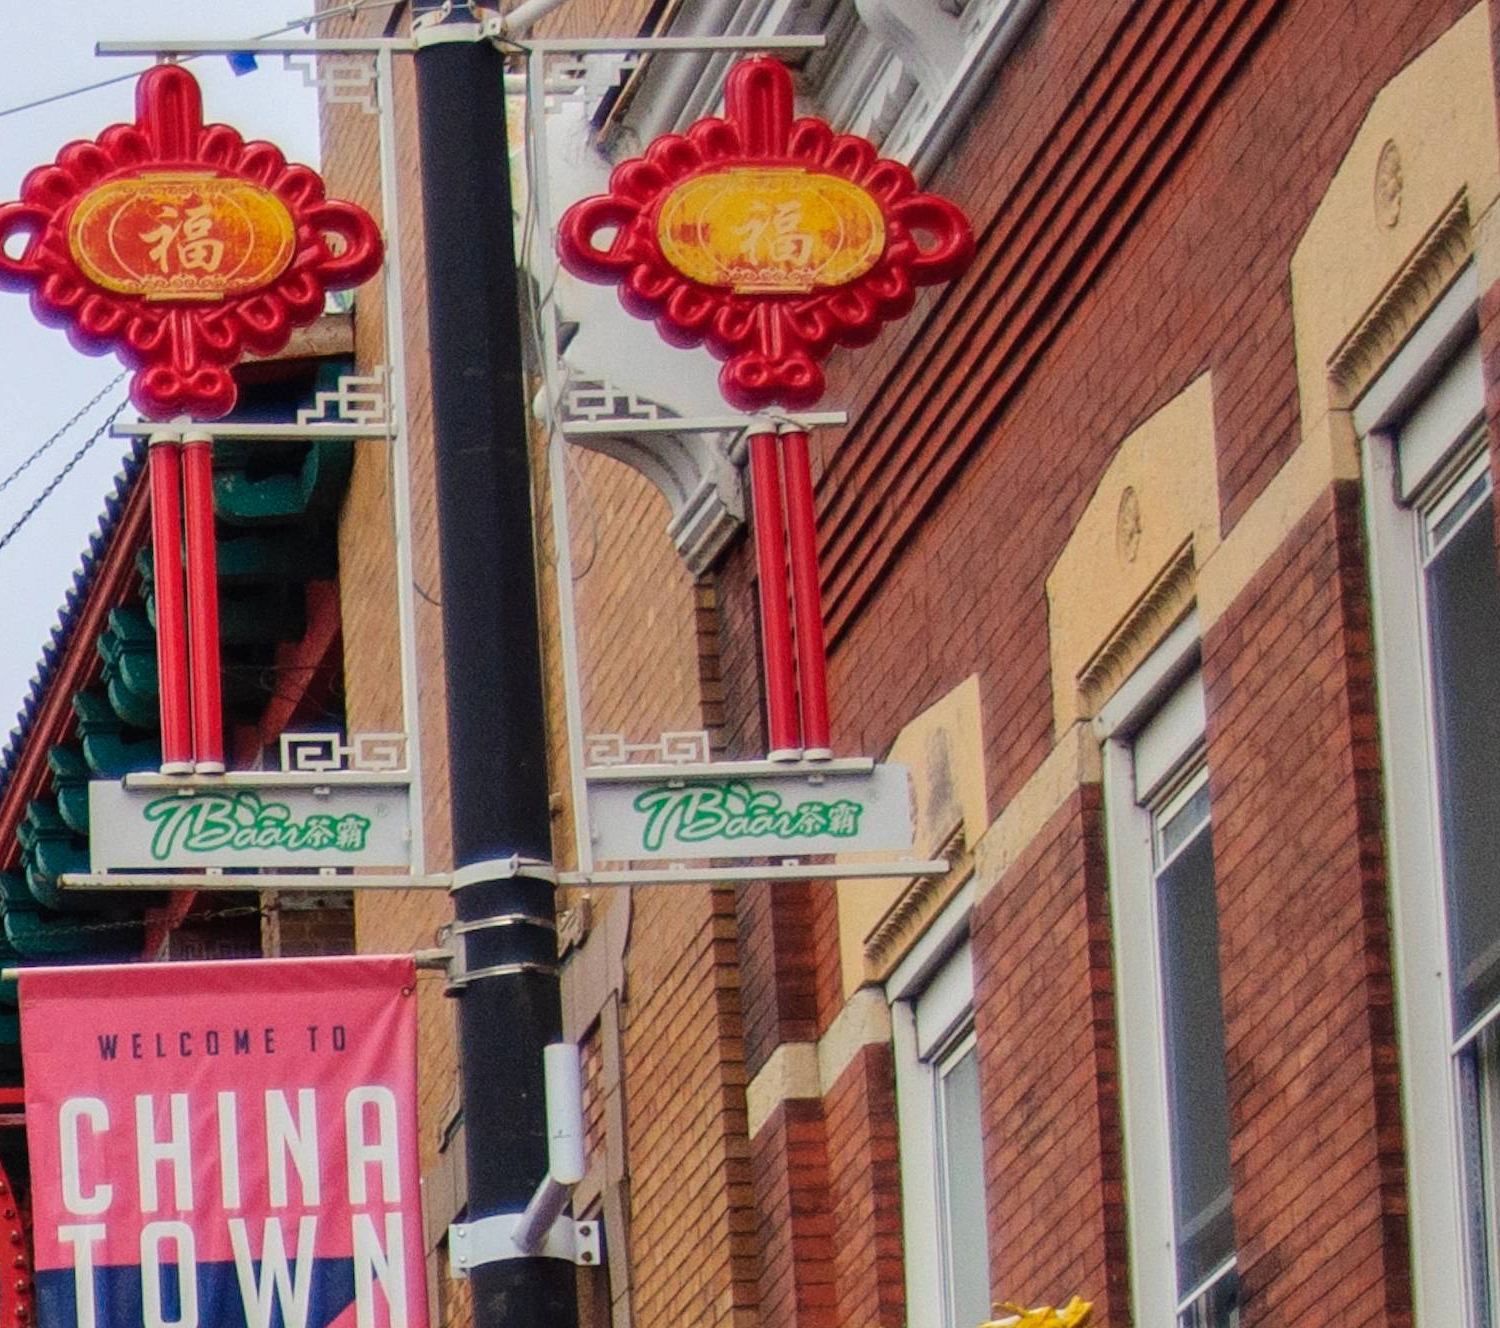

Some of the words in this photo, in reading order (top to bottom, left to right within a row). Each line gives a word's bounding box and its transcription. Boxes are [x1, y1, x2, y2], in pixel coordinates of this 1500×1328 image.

[139, 206, 224, 275] 福
[732, 199, 815, 269] 福
[99, 1029, 280, 1061] WELCOME
[306, 1025, 349, 1053] TO
[58, 1085, 401, 1220] CHINA
